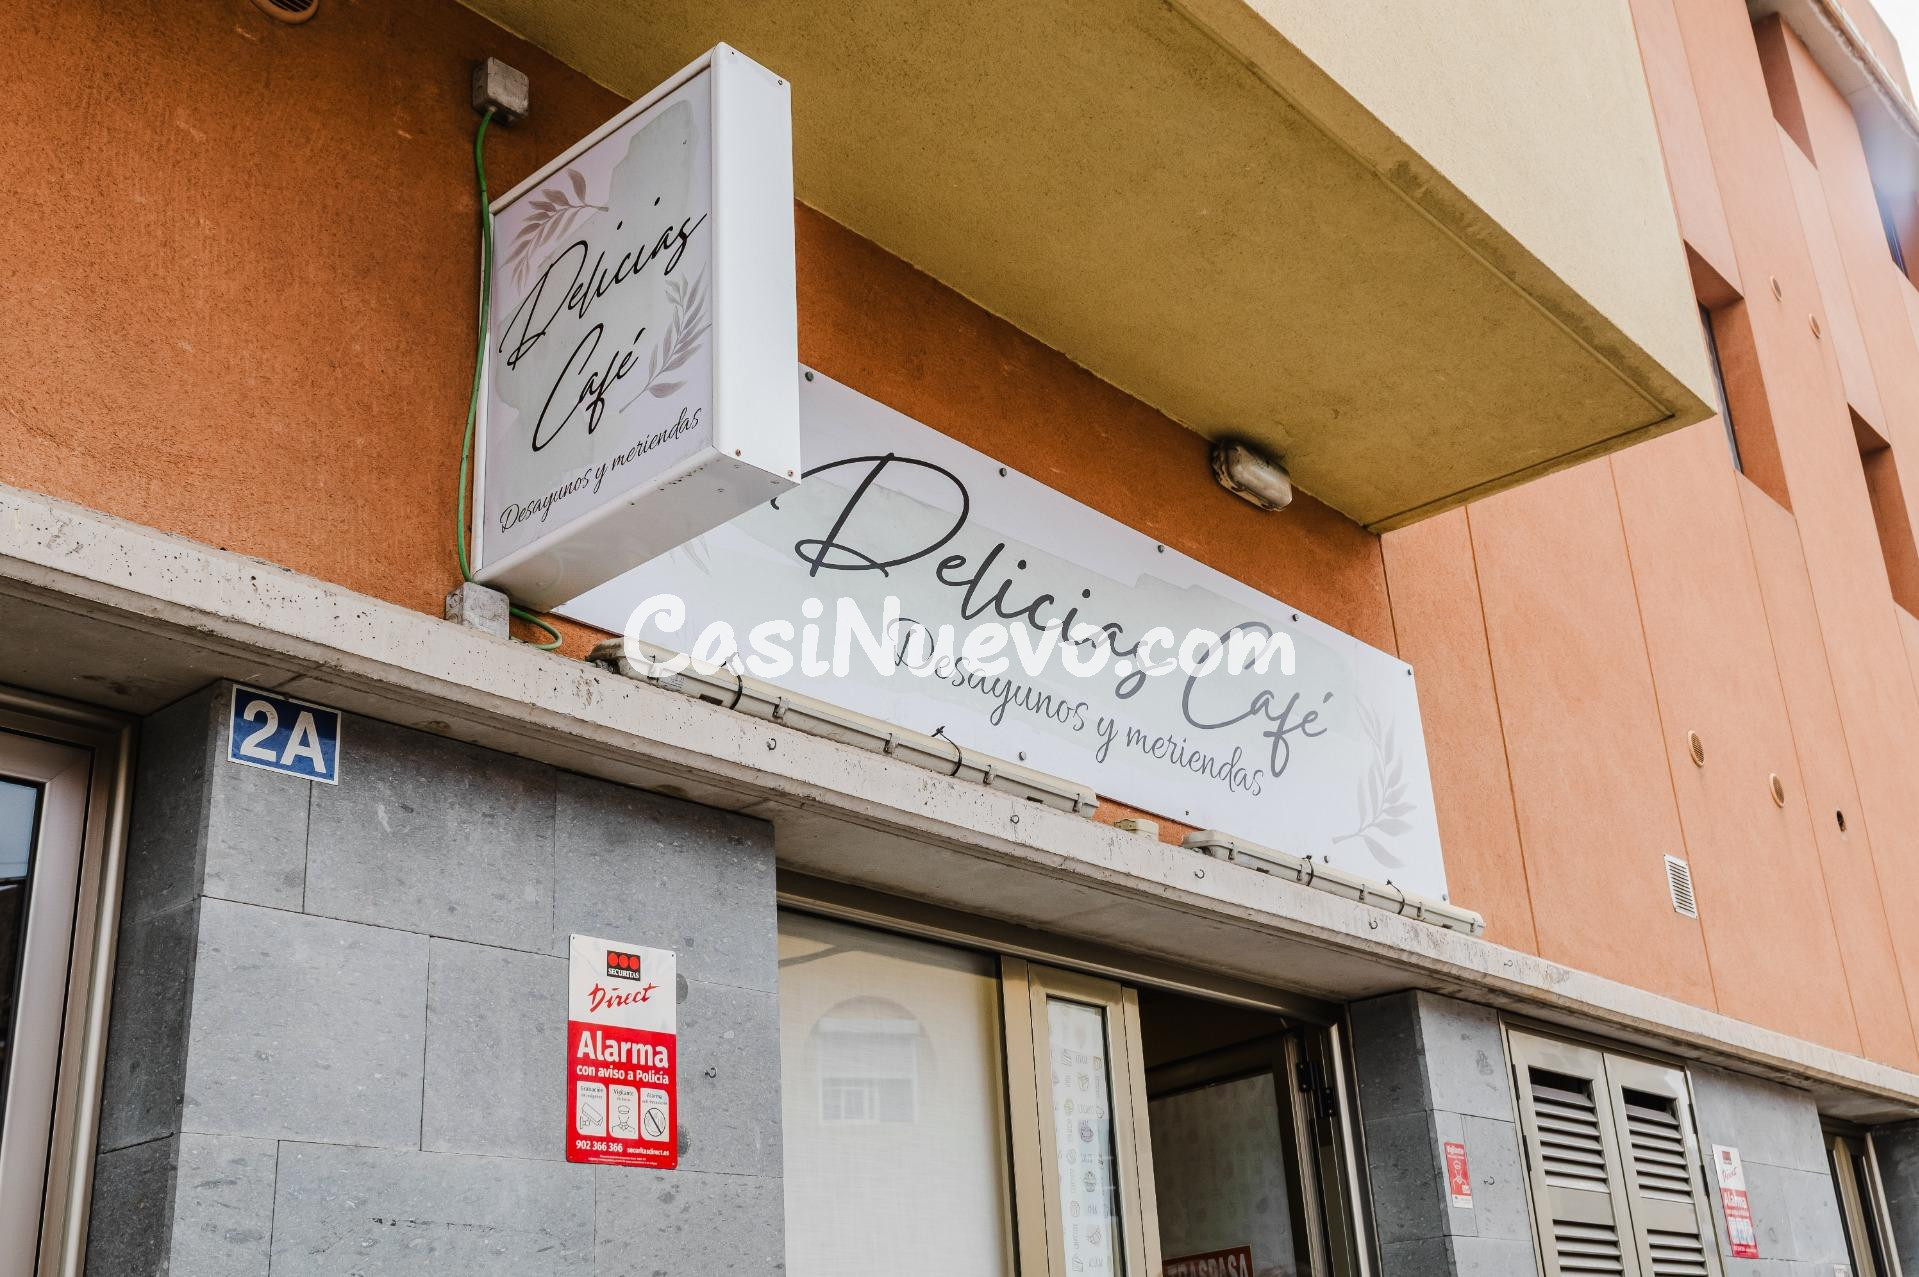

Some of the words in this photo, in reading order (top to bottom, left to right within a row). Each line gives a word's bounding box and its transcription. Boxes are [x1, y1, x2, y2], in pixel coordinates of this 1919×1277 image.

[500, 197, 707, 371] Delicias
[531, 323, 646, 452] Café
[500, 468, 593, 533] Desayunos
[594, 462, 608, 494] y
[612, 407, 702, 471] meriendas
[771, 451, 1178, 700] Delicias
[1182, 620, 1335, 777] Café
[240, 699, 327, 774] 2A
[886, 617, 1089, 732] Desayunos
[1096, 714, 1119, 764] y
[1126, 724, 1265, 797] meriendas
[587, 982, 660, 1013] Direct
[608, 968, 640, 979] SECURITAS
[576, 1030, 669, 1069] Alarma
[576, 1065, 596, 1077] con
[598, 1065, 625, 1080] aviso
[627, 1070, 634, 1081] a
[636, 1069, 669, 1085] Policía
[575, 1139, 590, 1150] 902
[592, 1141, 607, 1151] 366
[608, 1142, 623, 1153] 366
